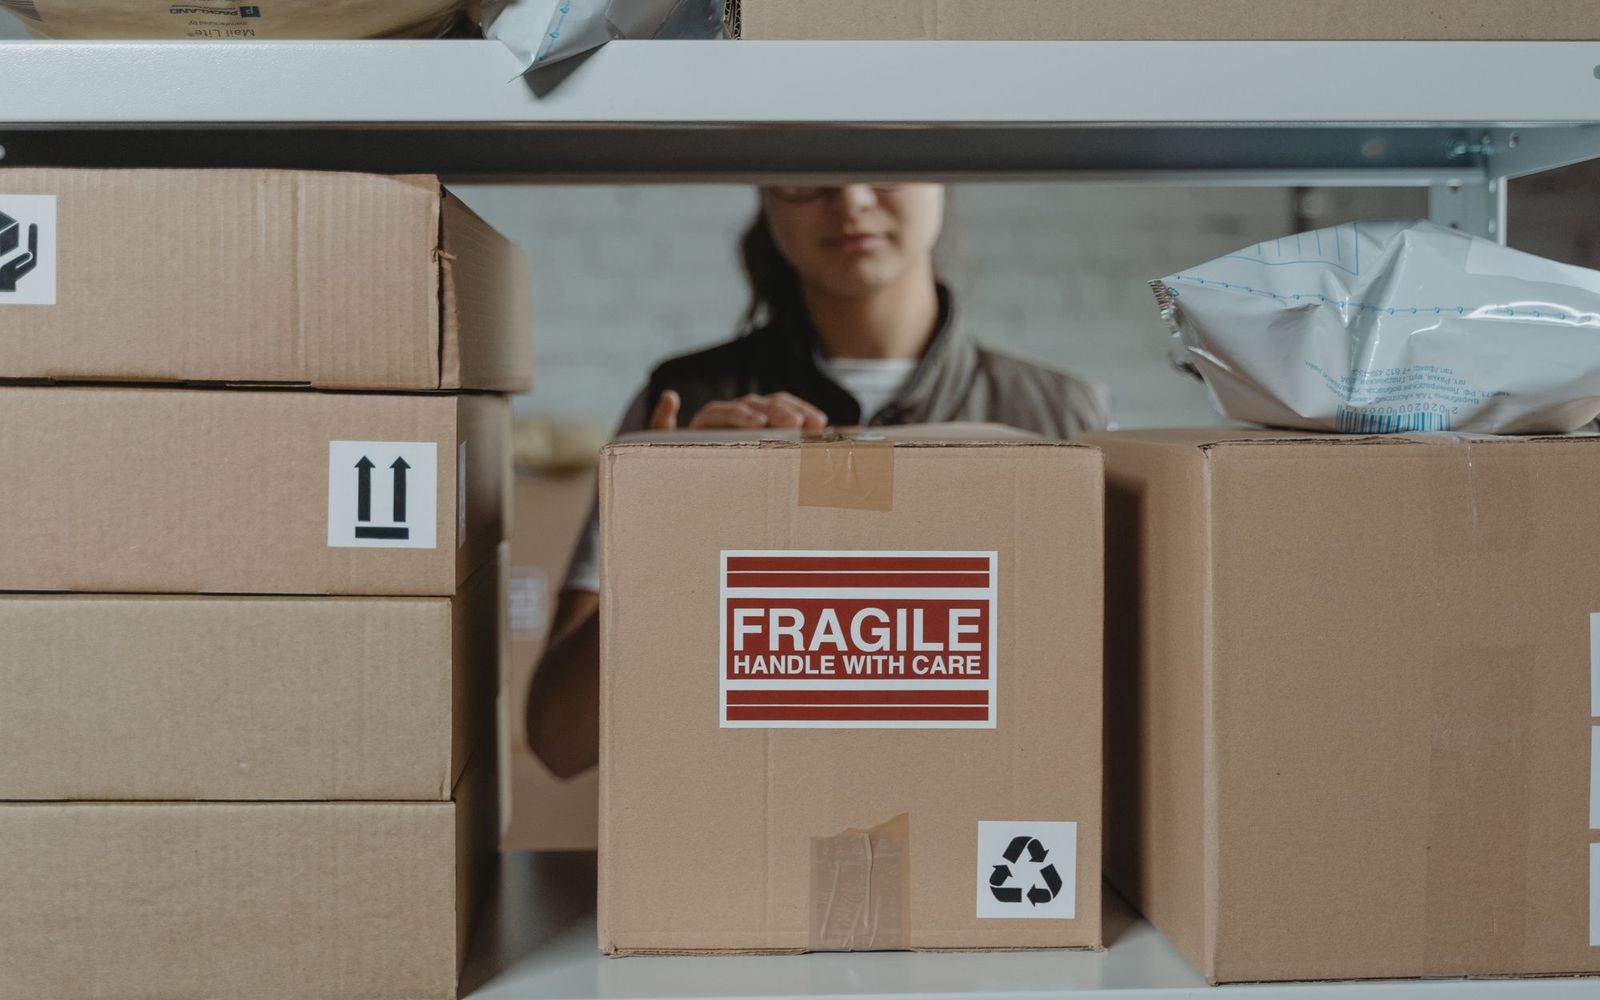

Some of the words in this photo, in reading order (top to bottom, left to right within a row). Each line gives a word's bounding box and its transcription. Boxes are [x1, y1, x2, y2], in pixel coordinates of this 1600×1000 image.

[168, 8, 239, 17] PACKLAND
[226, 28, 256, 38] Mail
[1399, 402, 1446, 414] 020200
[733, 607, 982, 652] FRAGILE
[733, 655, 835, 675] HANDLE
[843, 655, 905, 675] WITH
[912, 654, 982, 675] CARE
